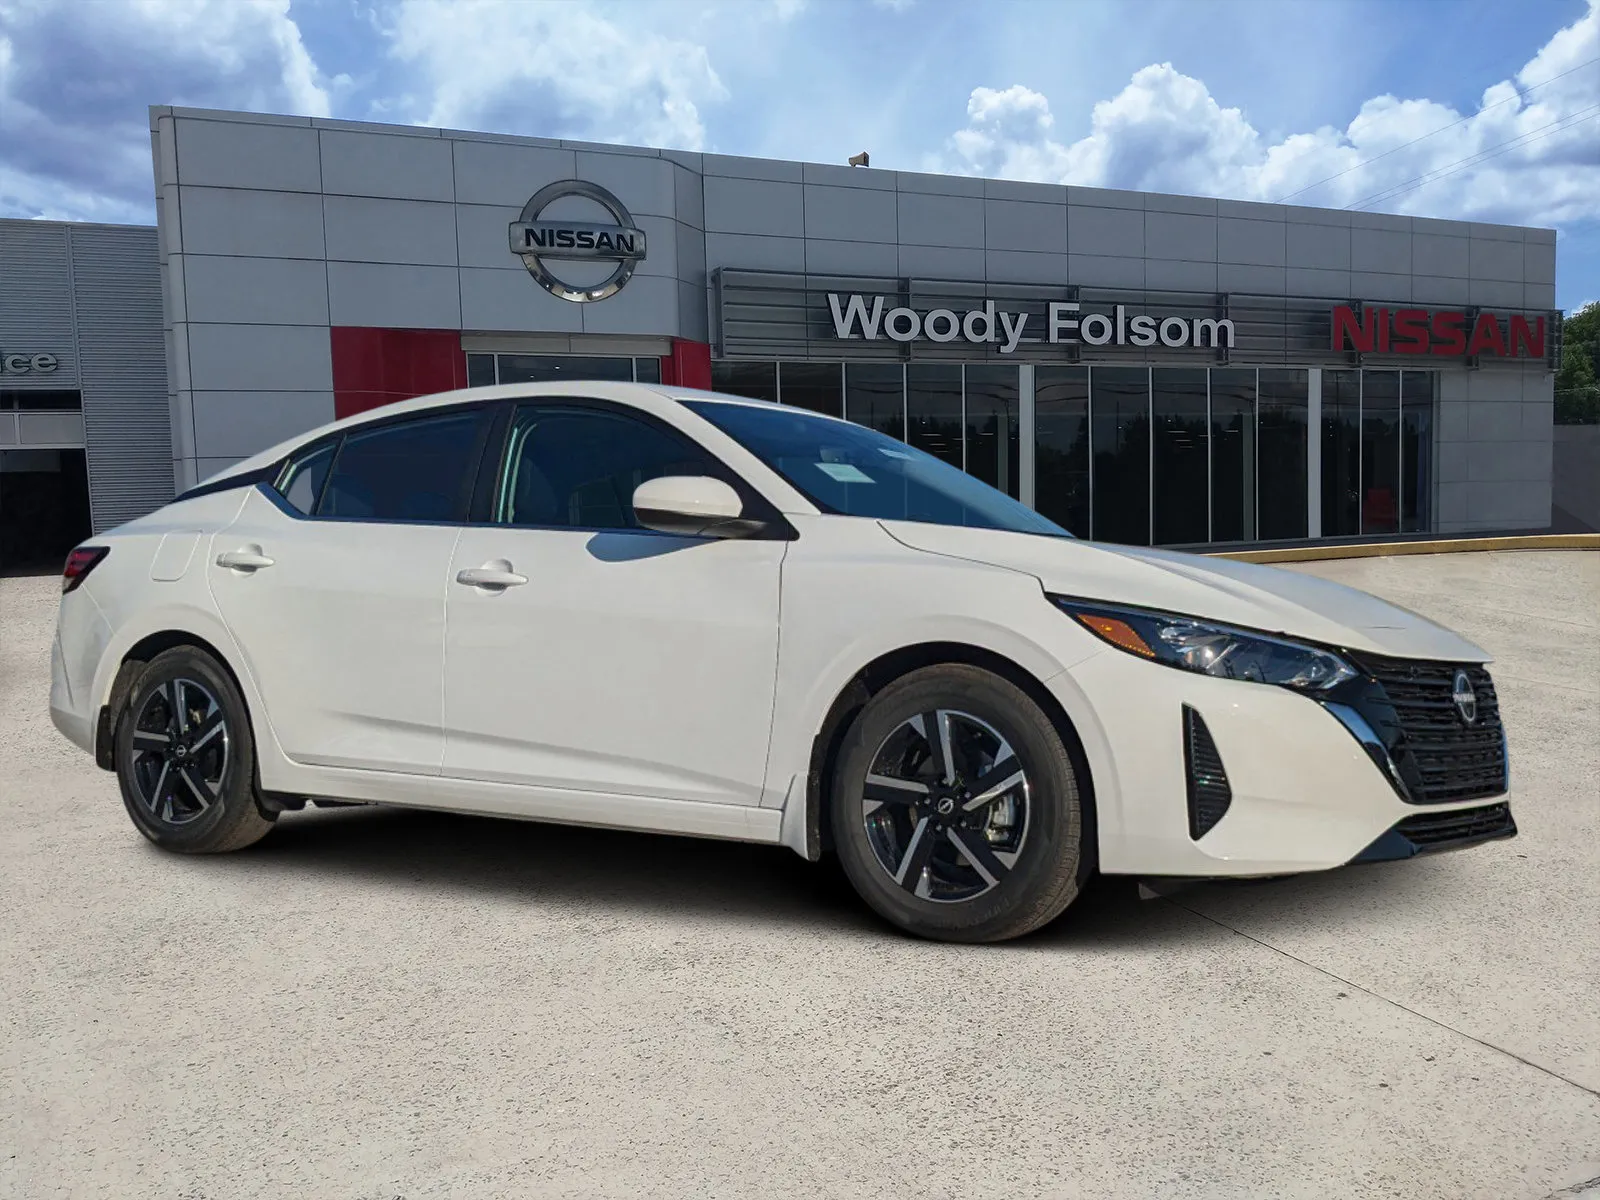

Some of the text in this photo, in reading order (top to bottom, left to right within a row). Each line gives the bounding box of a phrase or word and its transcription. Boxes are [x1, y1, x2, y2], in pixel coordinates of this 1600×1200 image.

[524, 228, 635, 253] NISSAN
[827, 292, 1236, 354] Woody Folsom
[1332, 305, 1545, 358] NISSAN
[0, 350, 58, 374] ce
